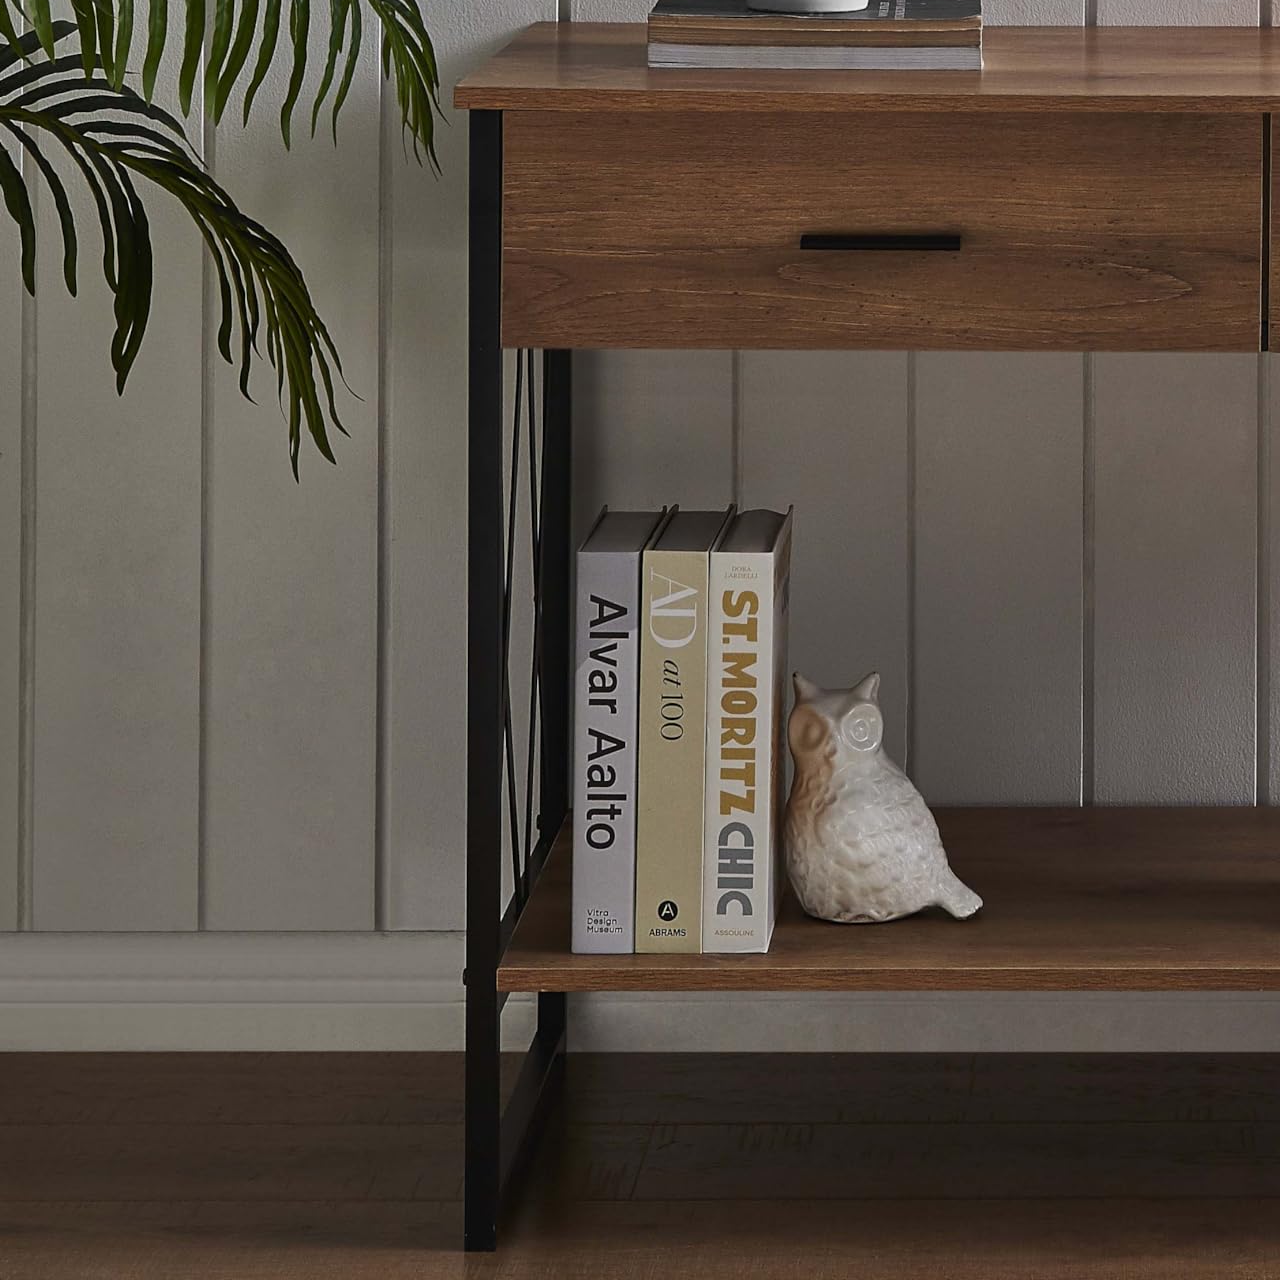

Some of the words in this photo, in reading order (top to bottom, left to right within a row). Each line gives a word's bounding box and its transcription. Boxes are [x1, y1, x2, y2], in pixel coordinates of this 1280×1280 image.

[650, 567, 698, 649] AD
[588, 594, 629, 715] Alvar
[663, 659, 681, 688] at
[660, 693, 684, 741] 100
[719, 652, 758, 816] MORITZ
[586, 727, 627, 850] Aalto
[716, 821, 754, 916] CHIC
[587, 909, 609, 917] Vitra
[587, 918, 618, 926] Design
[587, 926, 623, 934] Museum
[649, 928, 687, 937] ABRAMS
[714, 929, 754, 937] ASSOULINE
